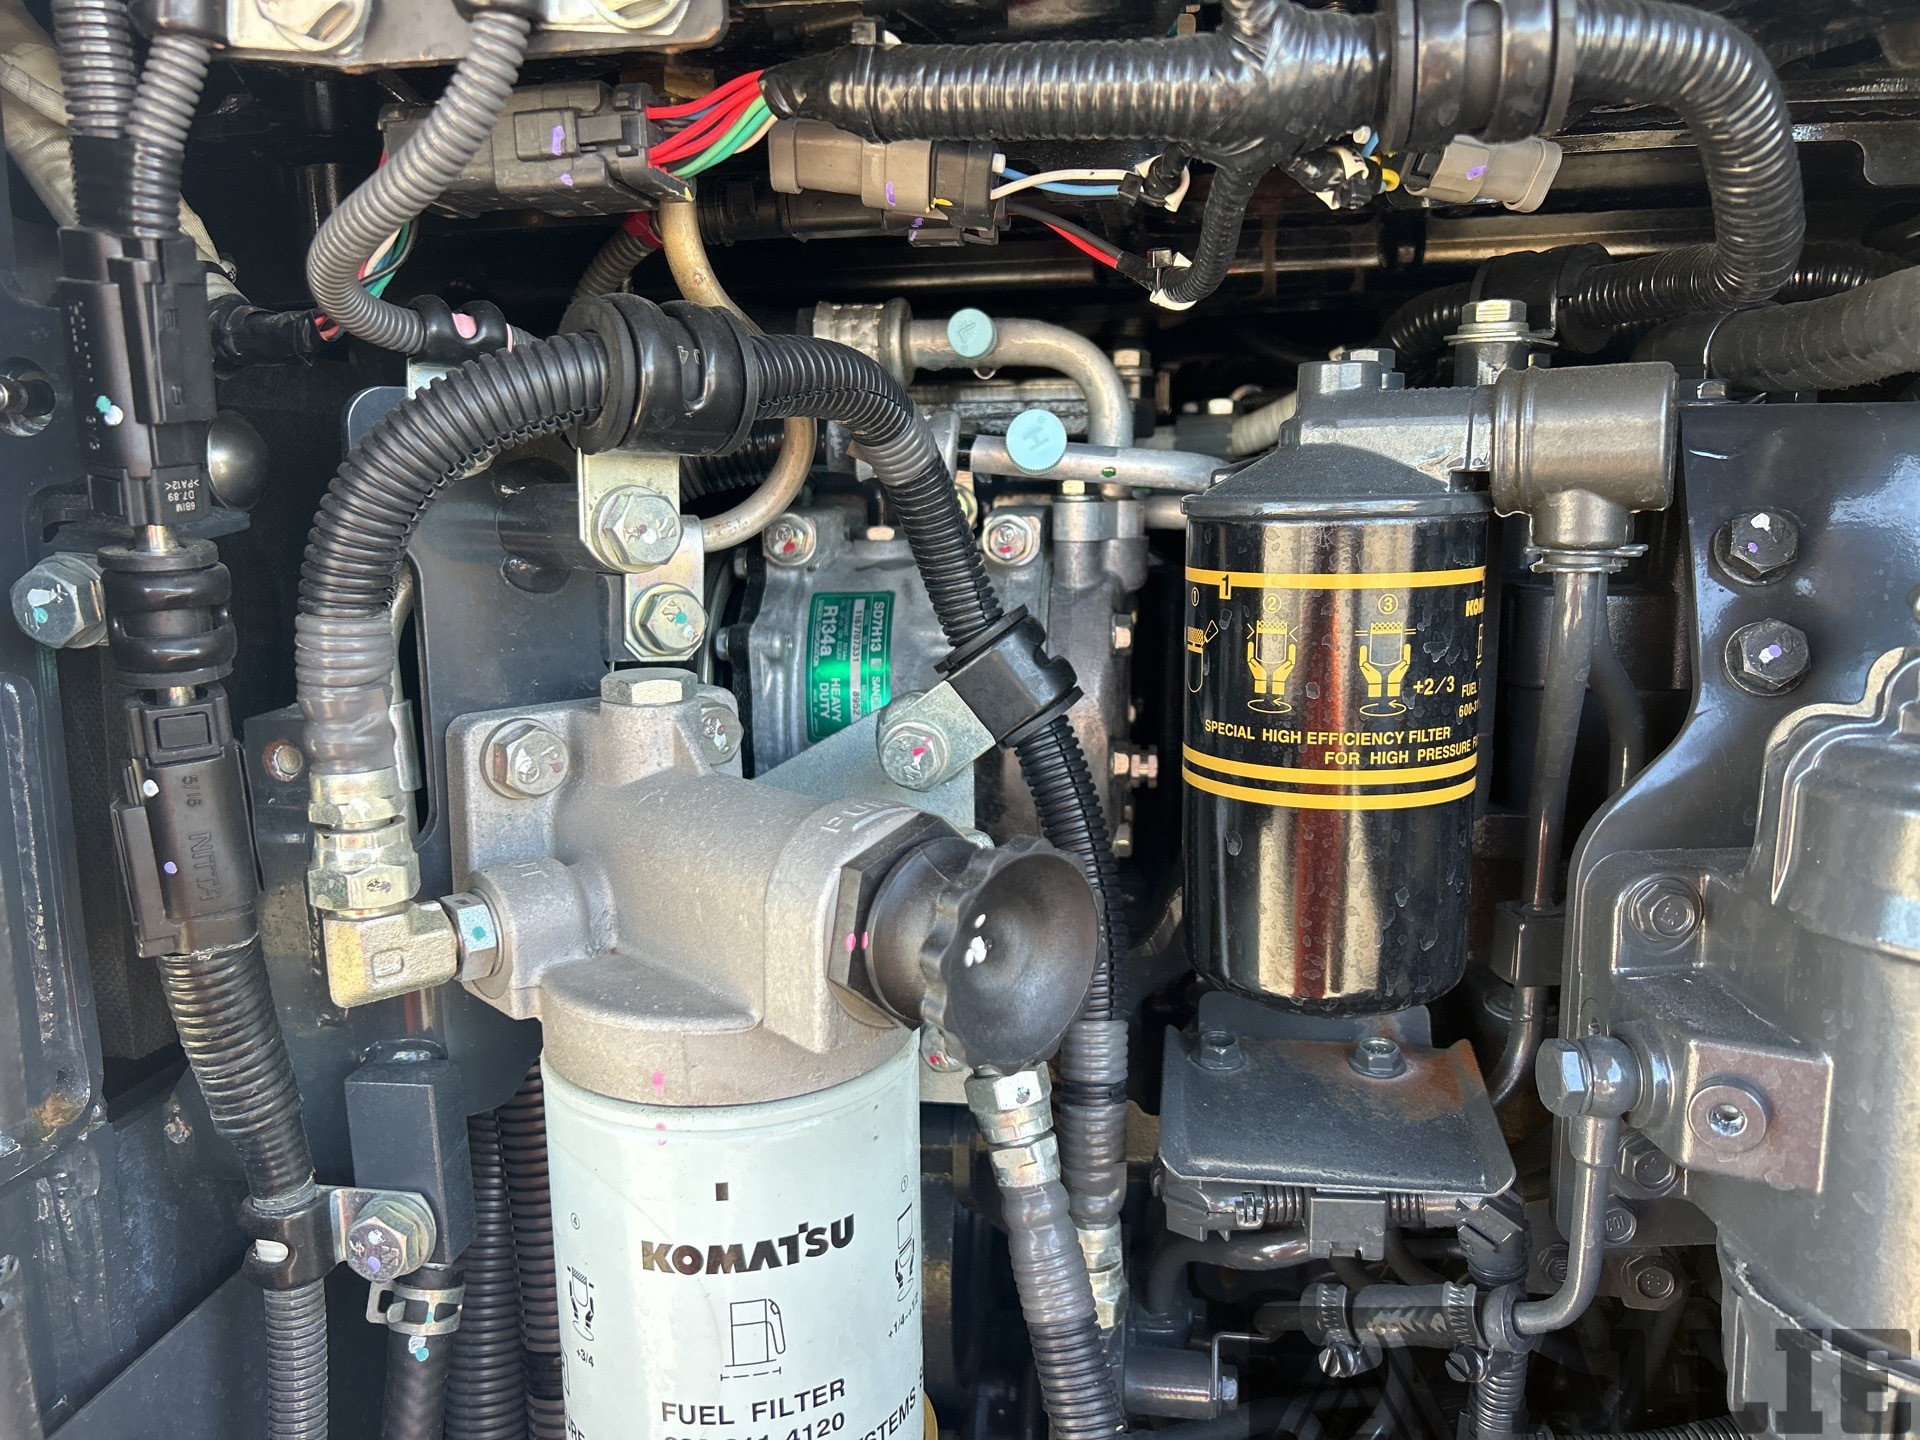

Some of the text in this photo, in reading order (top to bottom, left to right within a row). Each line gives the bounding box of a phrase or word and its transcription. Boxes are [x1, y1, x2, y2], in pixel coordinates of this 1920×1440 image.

[819, 604, 840, 657] R134a
[870, 601, 886, 653] SD7H13
[819, 682, 830, 719] DUTY
[830, 677, 842, 723] HEAVY
[852, 690, 861, 716] 8952
[1412, 675, 1455, 697] +2/3
[1204, 719, 1451, 746] SPECIAL HIGH EFFICIENCY FILTER
[1324, 750, 1361, 766] FOR
[1370, 751, 1410, 766] HIGH
[1417, 738, 1472, 762] PRESSURE
[640, 1212, 856, 1276] KOMATSU
[661, 1377, 846, 1426] FUEL FILTER
